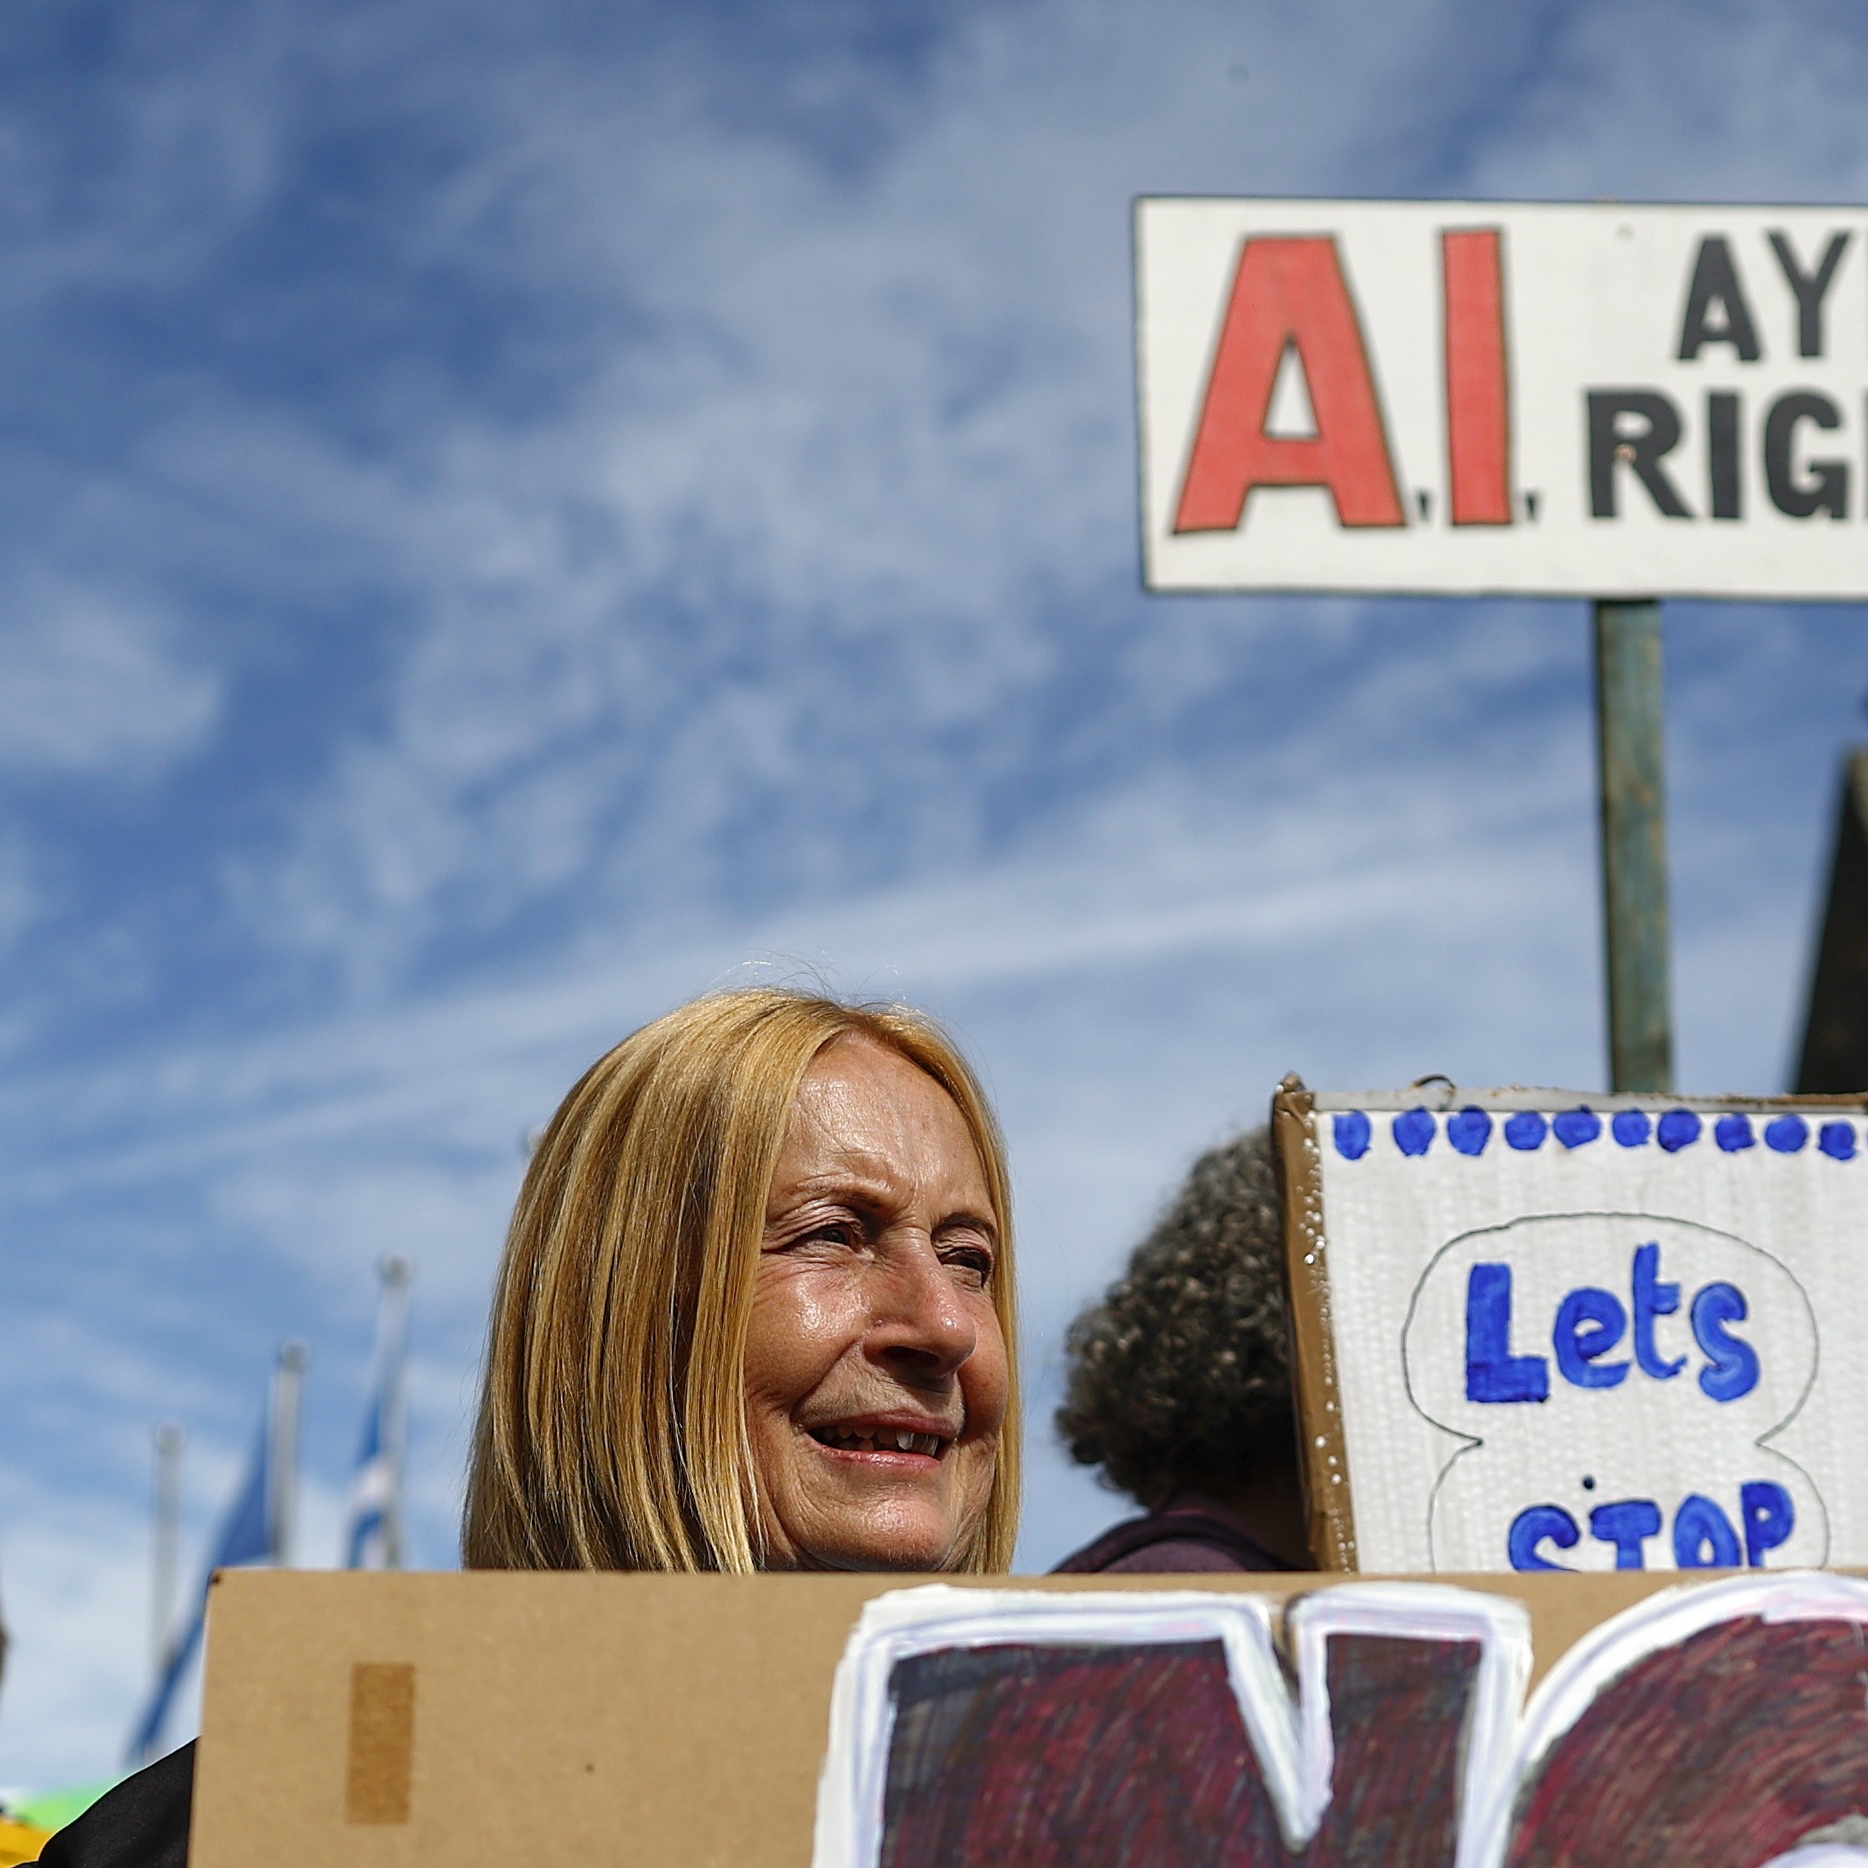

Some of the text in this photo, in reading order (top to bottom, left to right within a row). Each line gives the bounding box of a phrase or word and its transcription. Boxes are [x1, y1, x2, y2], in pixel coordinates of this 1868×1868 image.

[1171, 227, 1542, 534] A.I.
[1465, 1241, 1761, 1404] Lets
[1509, 1480, 1795, 1572] STOP
